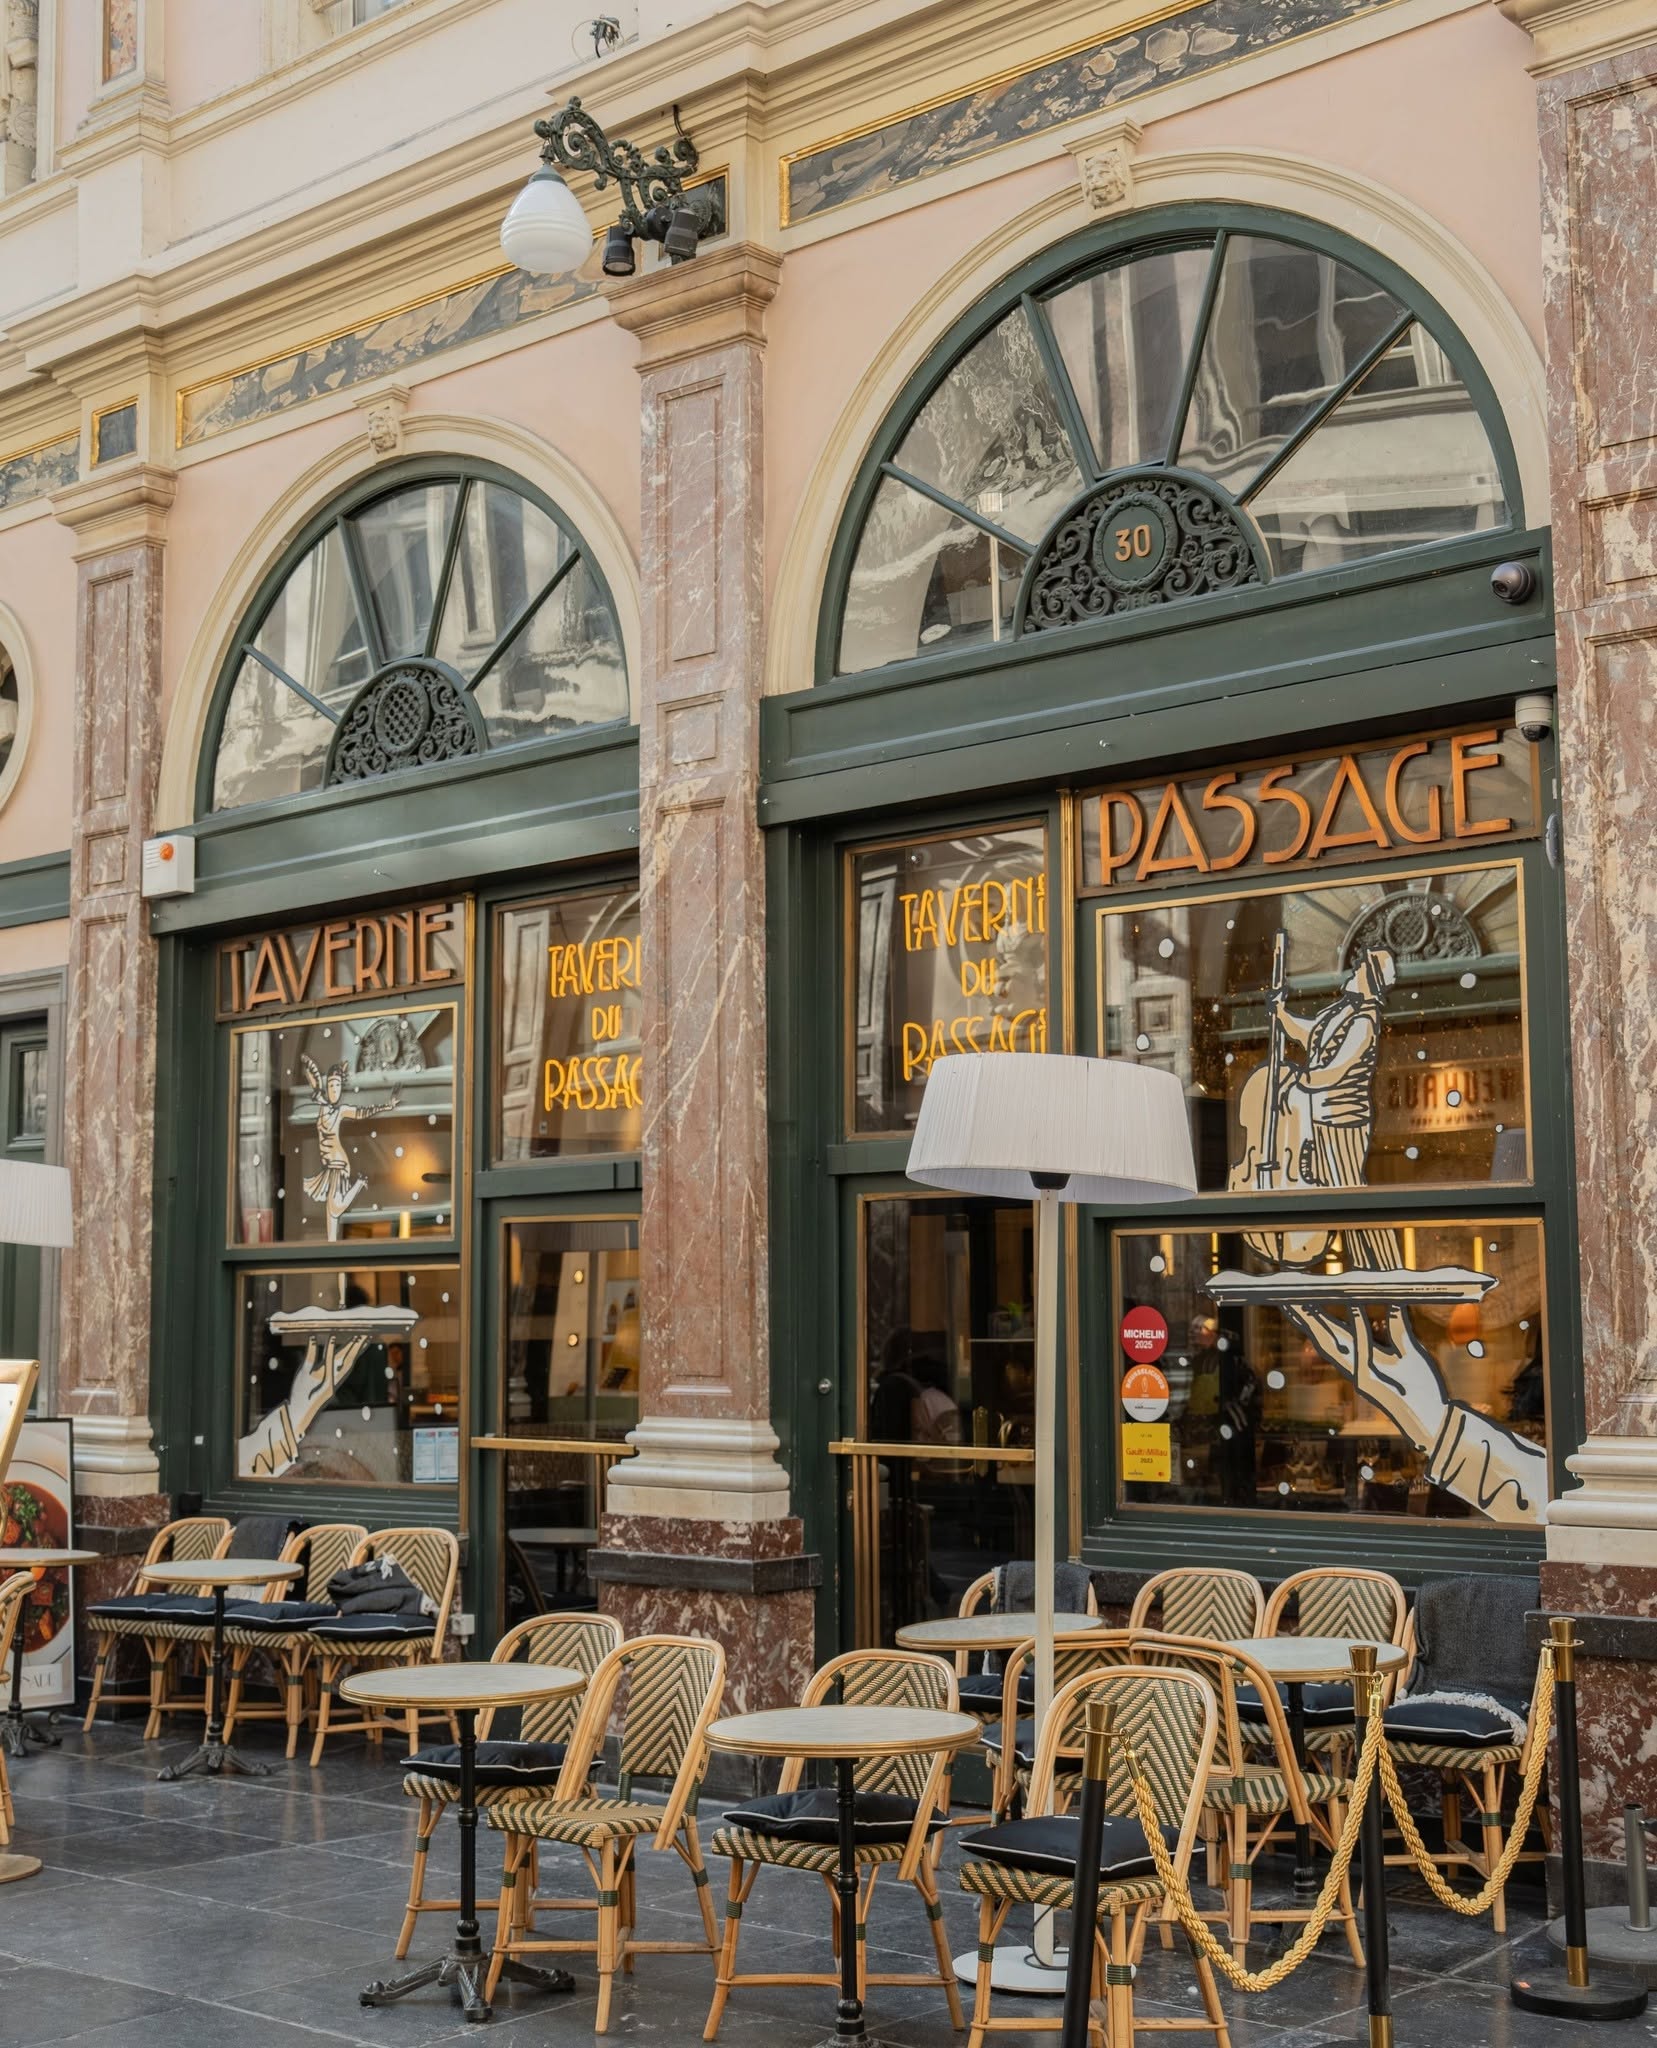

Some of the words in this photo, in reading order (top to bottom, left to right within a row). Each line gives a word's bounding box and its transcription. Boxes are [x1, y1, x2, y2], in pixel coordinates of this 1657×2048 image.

[1115, 524, 1151, 561] 30
[1101, 729, 1511, 886] PASSAGE
[222, 903, 456, 1013] TAVERNE
[960, 957, 996, 998] DU
[591, 1004, 622, 1040] DU
[1123, 1328, 1165, 1340] MICHELIN
[1134, 1339, 1154, 1350] 2025
